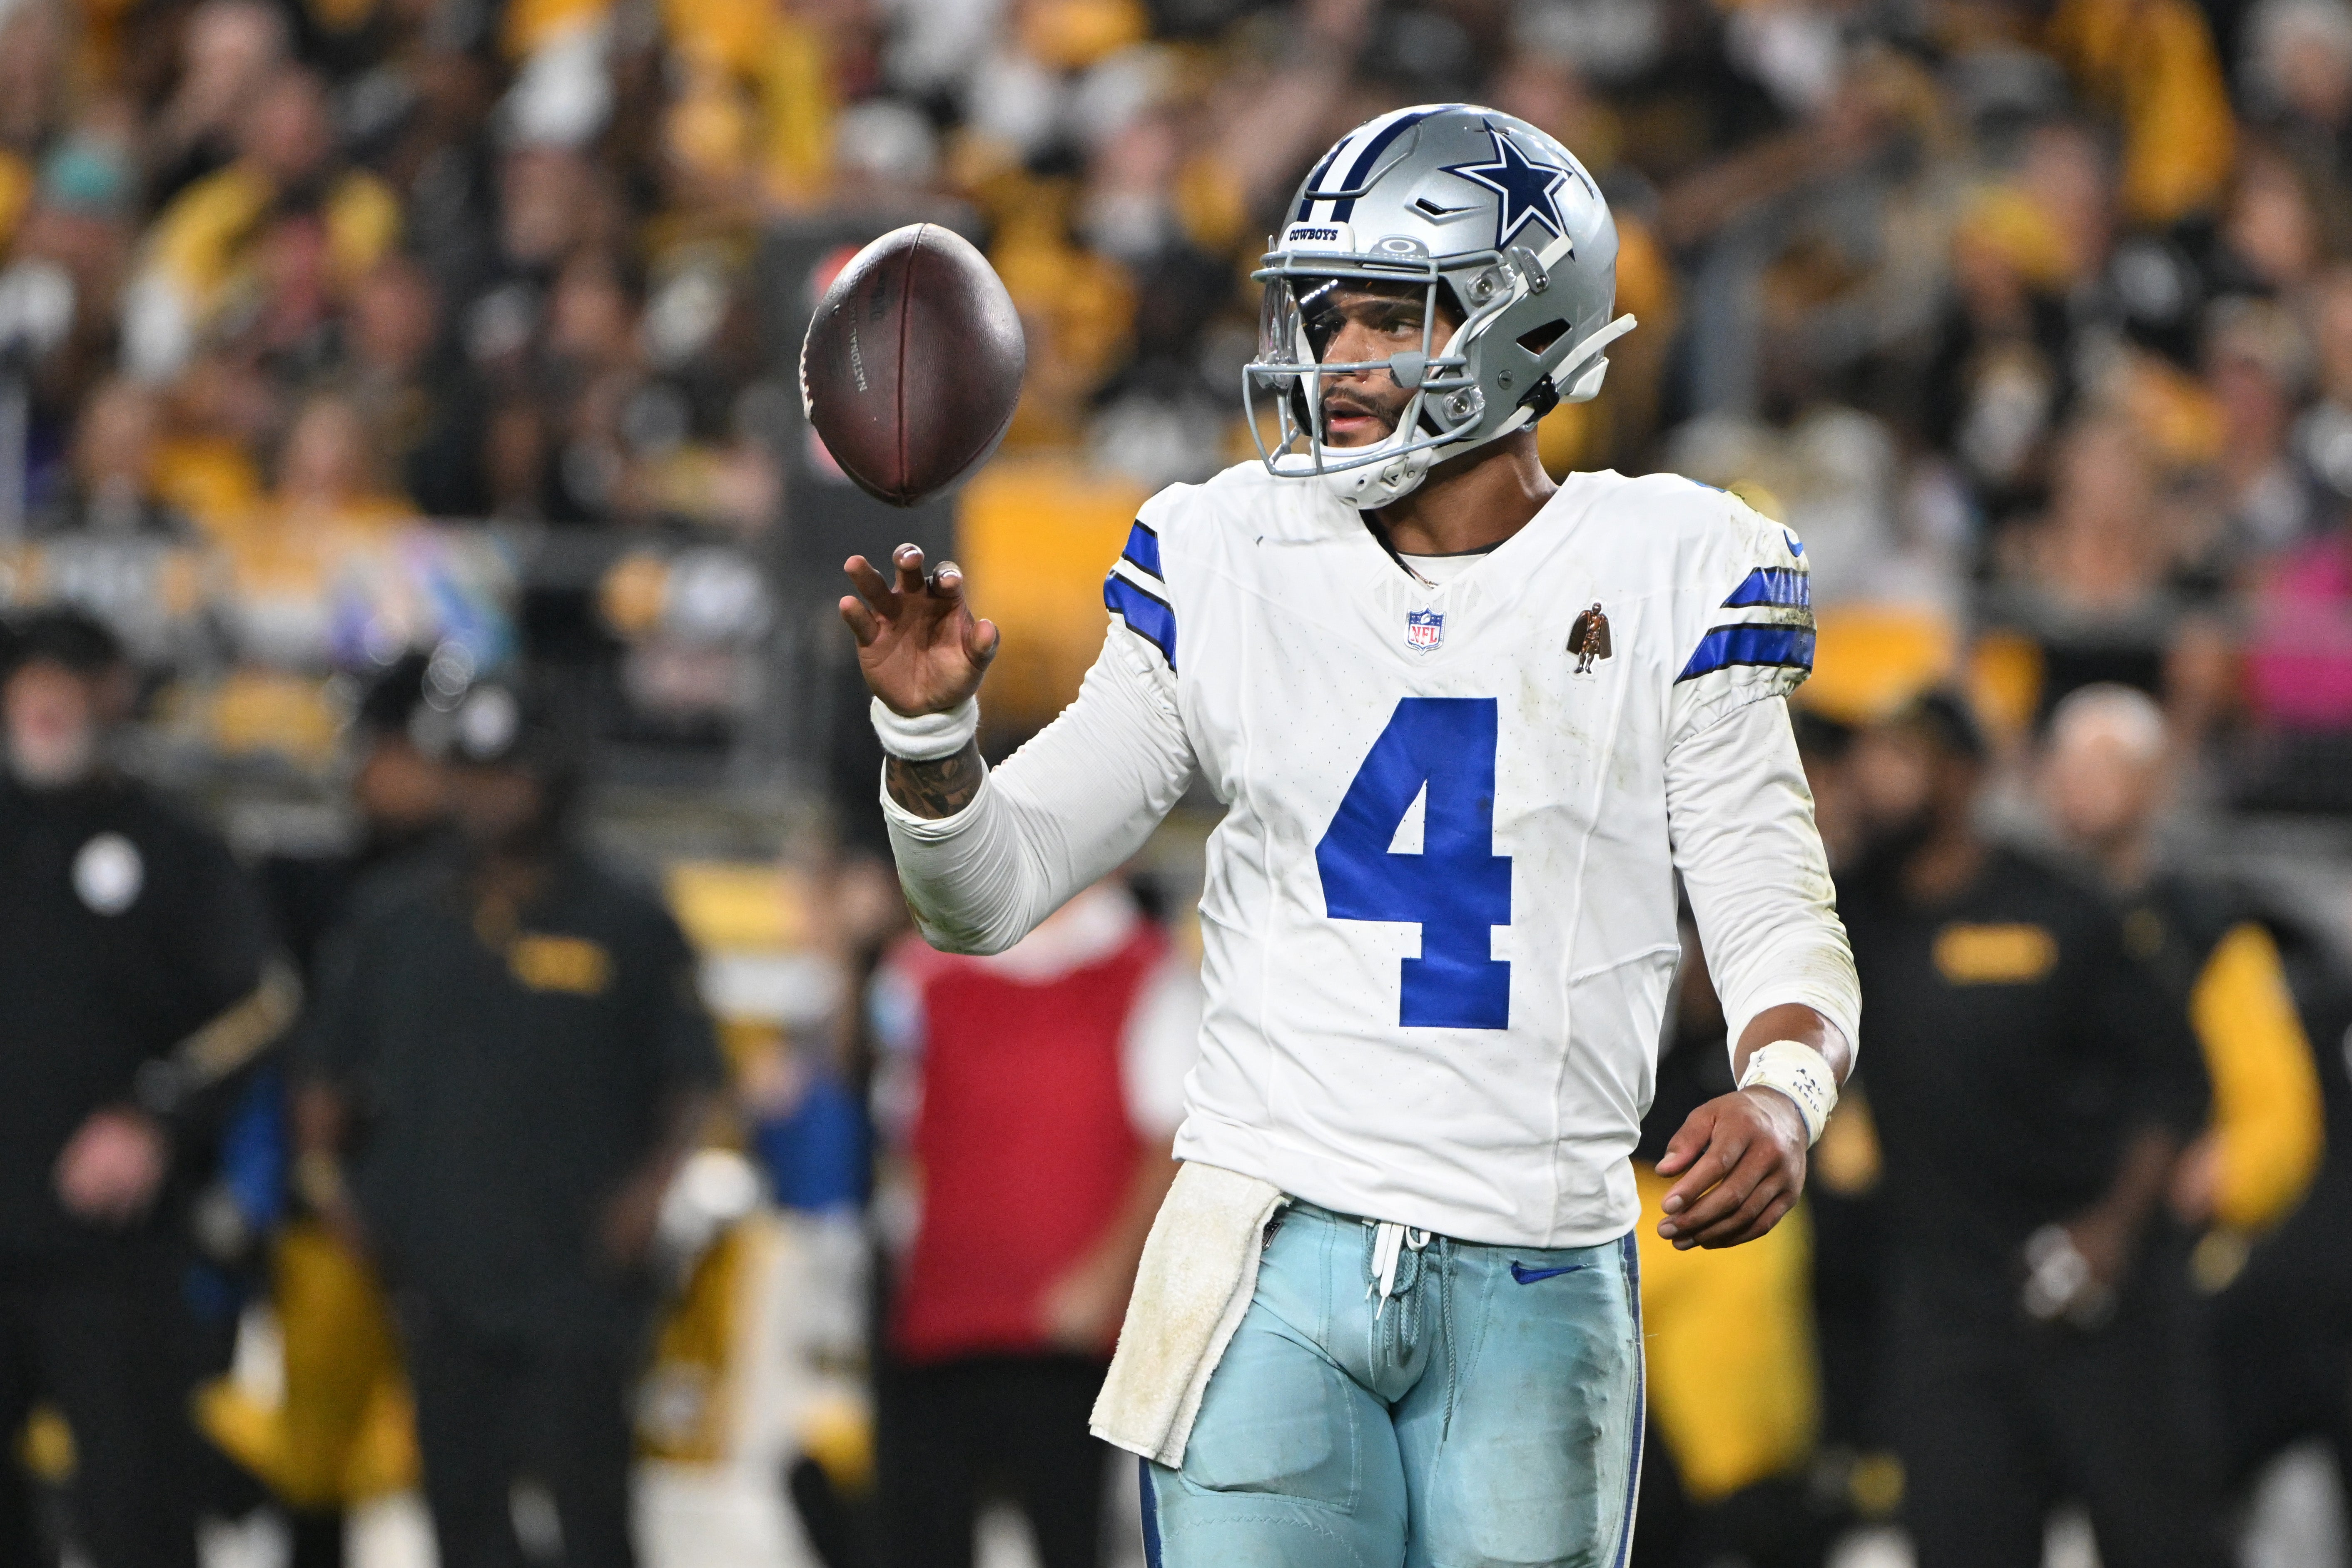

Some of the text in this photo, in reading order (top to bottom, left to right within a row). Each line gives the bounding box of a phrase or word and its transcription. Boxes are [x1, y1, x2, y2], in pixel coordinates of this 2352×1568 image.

[1289, 228, 1338, 241] COWBOYS
[849, 328, 867, 391] NATIONAL
[1410, 626, 1437, 645] NFL
[1315, 697, 1512, 1030] 4
